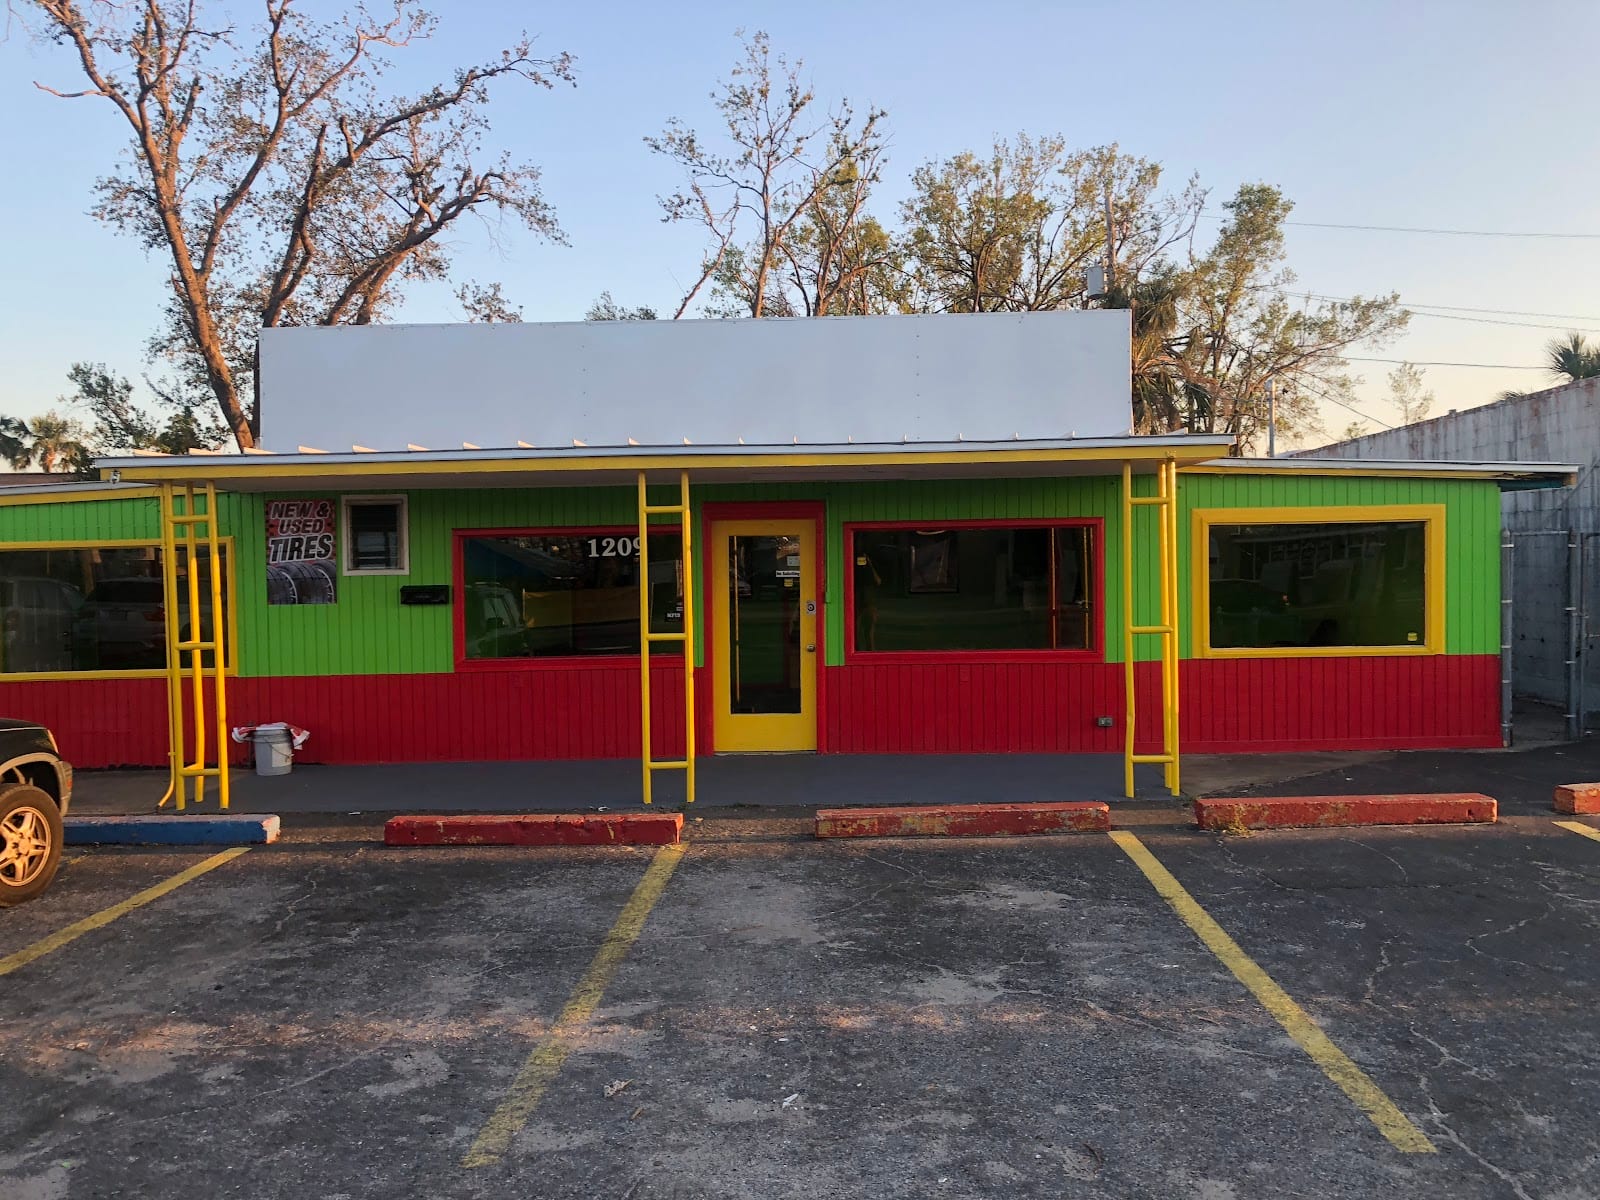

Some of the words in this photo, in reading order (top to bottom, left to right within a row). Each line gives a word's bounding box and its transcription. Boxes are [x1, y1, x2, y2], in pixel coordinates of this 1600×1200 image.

[271, 502, 314, 519] NEW
[315, 502, 330, 518] &
[278, 518, 325, 535] USED
[269, 533, 334, 563] TIRES
